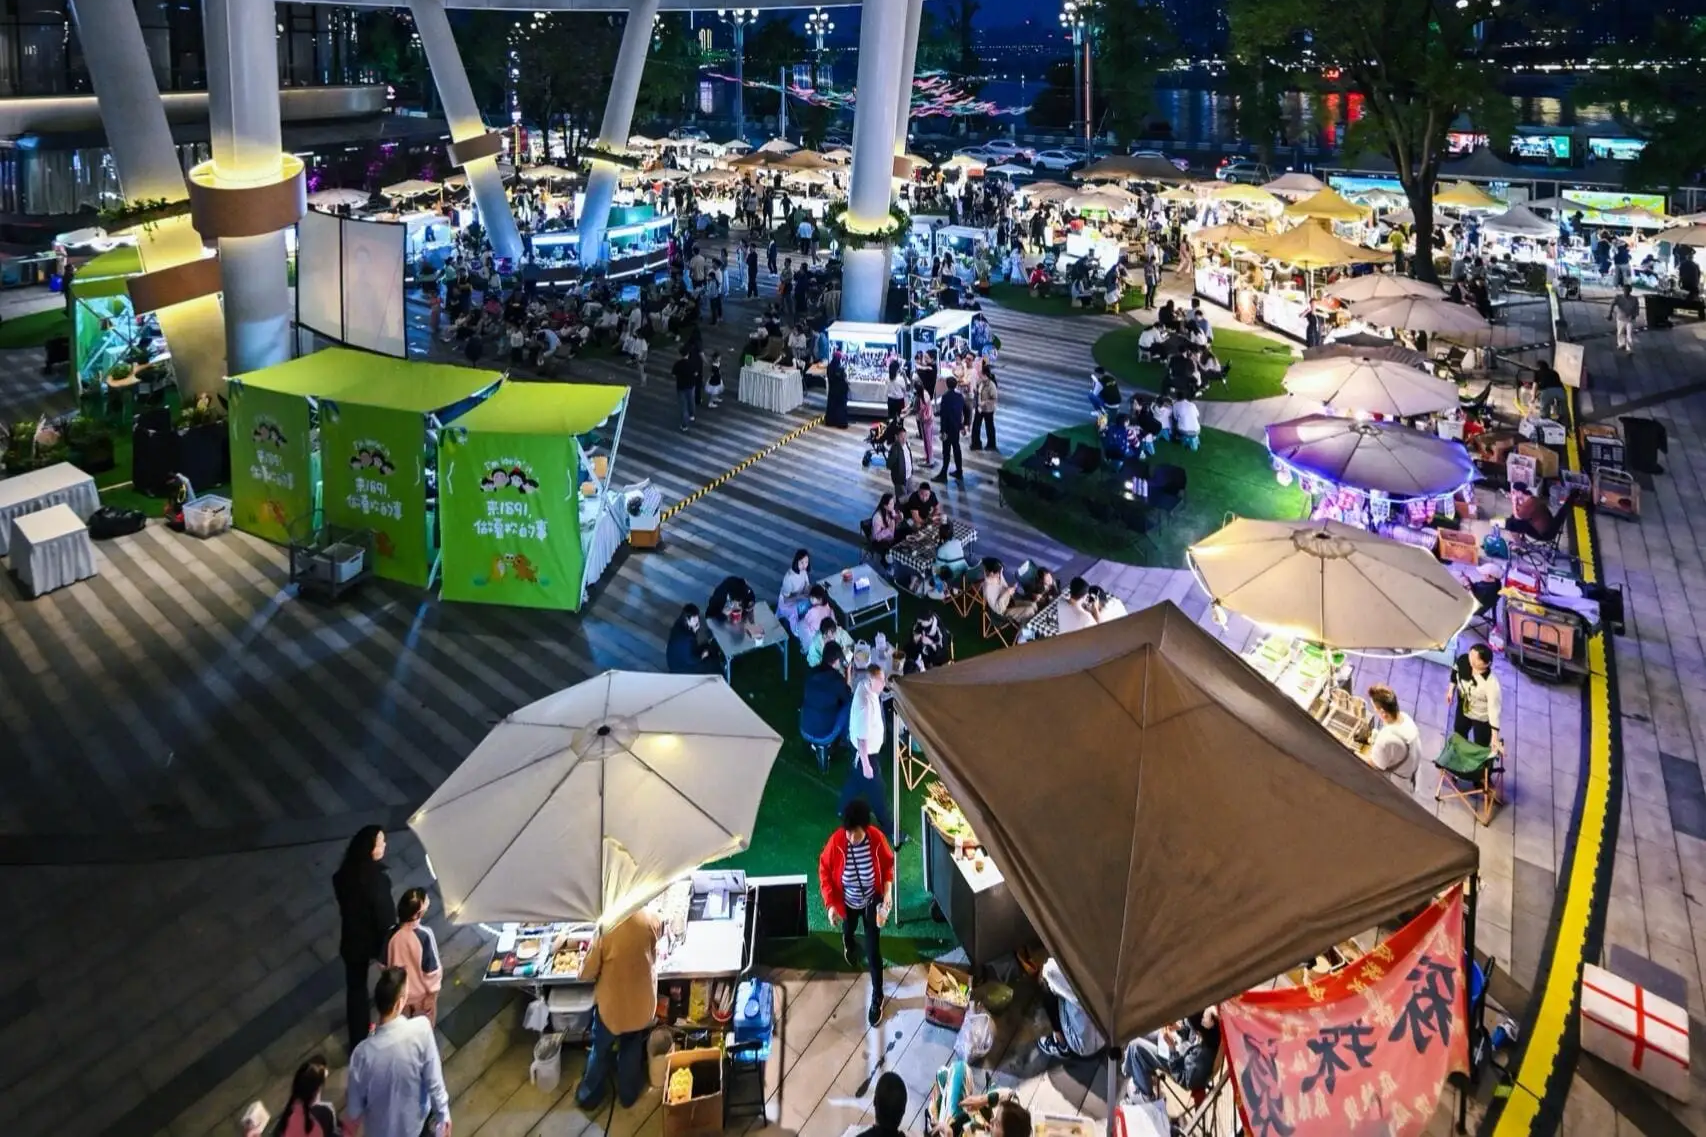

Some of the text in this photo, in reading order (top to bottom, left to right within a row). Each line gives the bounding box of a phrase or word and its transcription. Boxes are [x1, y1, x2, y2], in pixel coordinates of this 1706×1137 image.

[473, 518, 547, 542] 做喜欢的事
